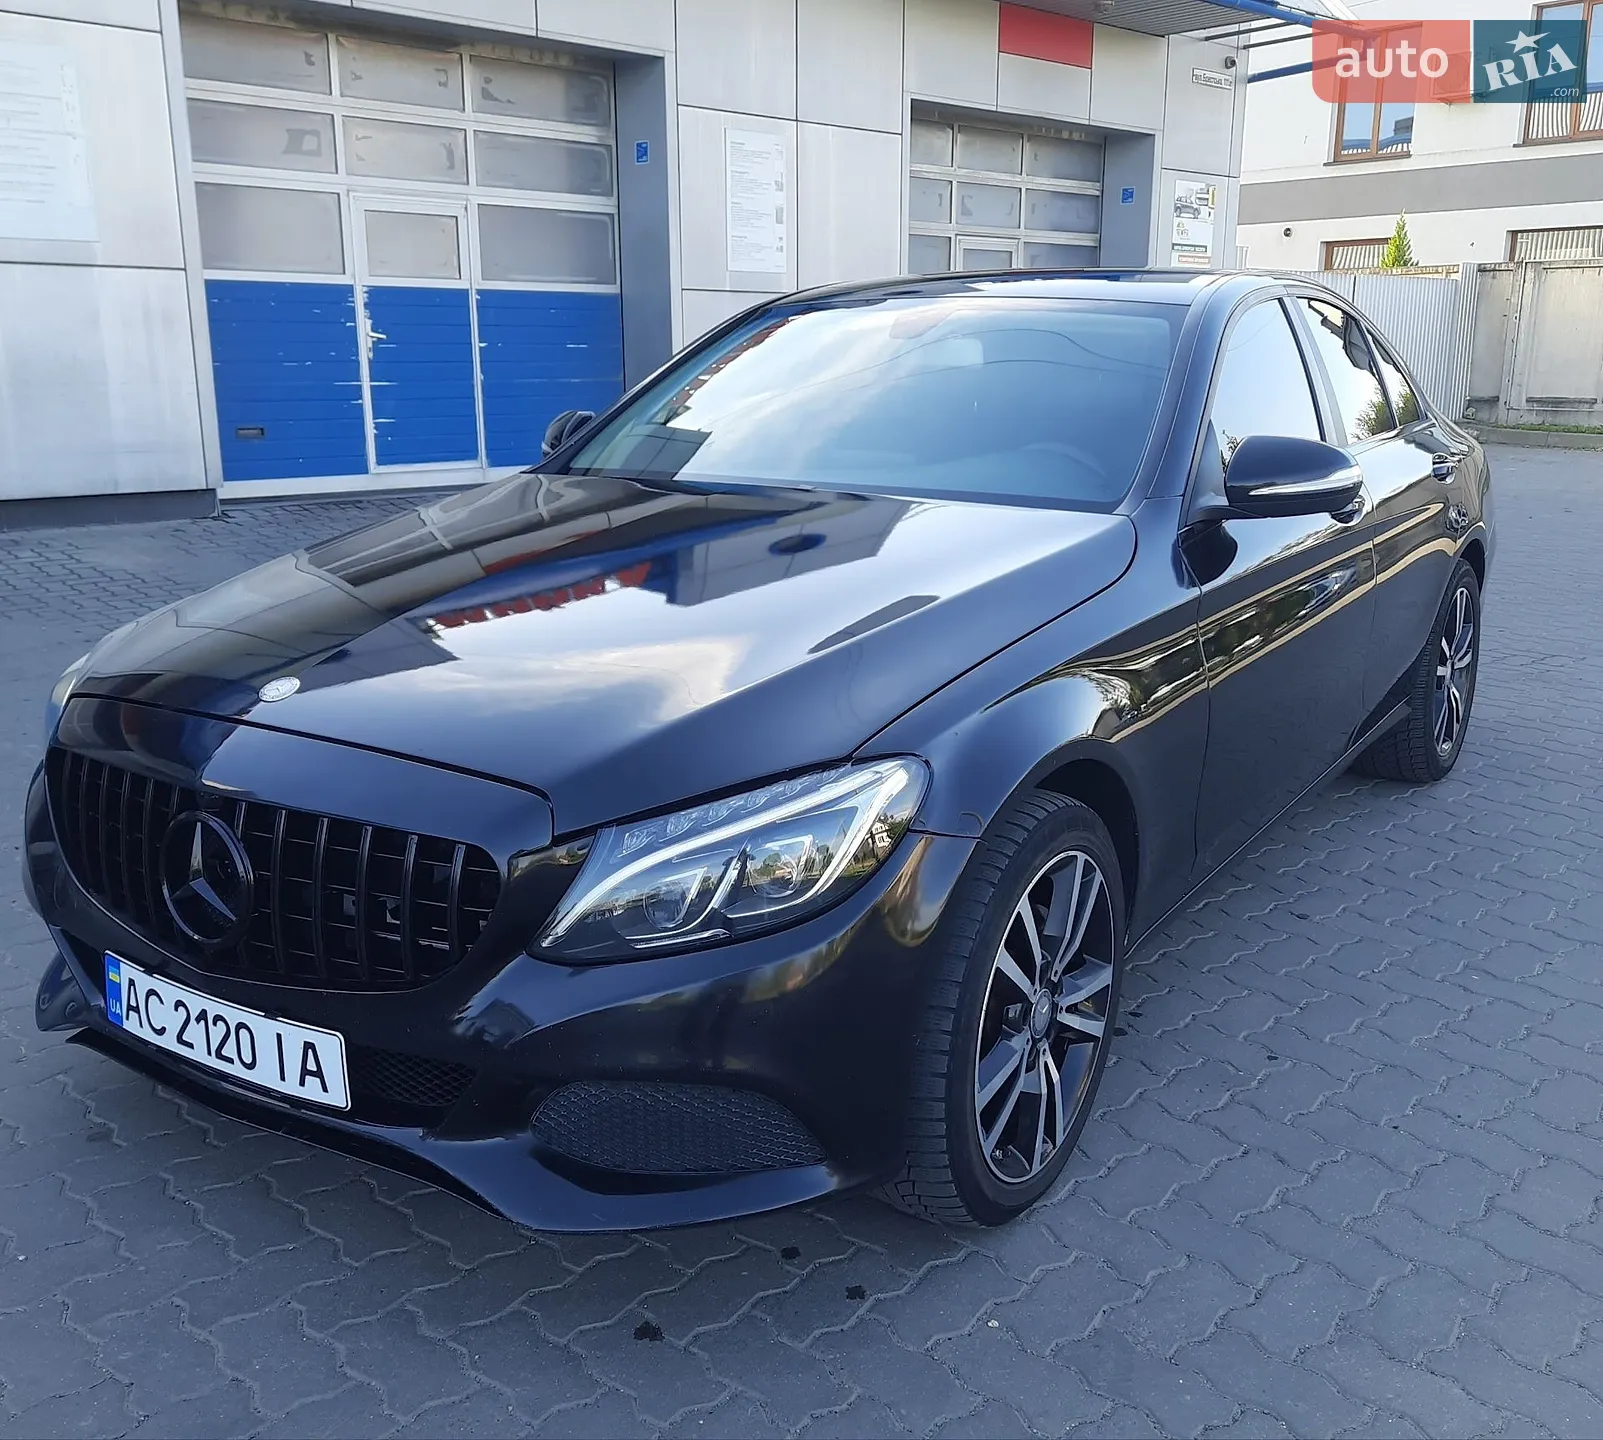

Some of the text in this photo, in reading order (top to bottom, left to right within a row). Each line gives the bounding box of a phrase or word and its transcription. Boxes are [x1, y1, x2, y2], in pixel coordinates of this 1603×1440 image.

[110, 997, 121, 1016] UA
[125, 977, 329, 1093] AC 2120 IA
